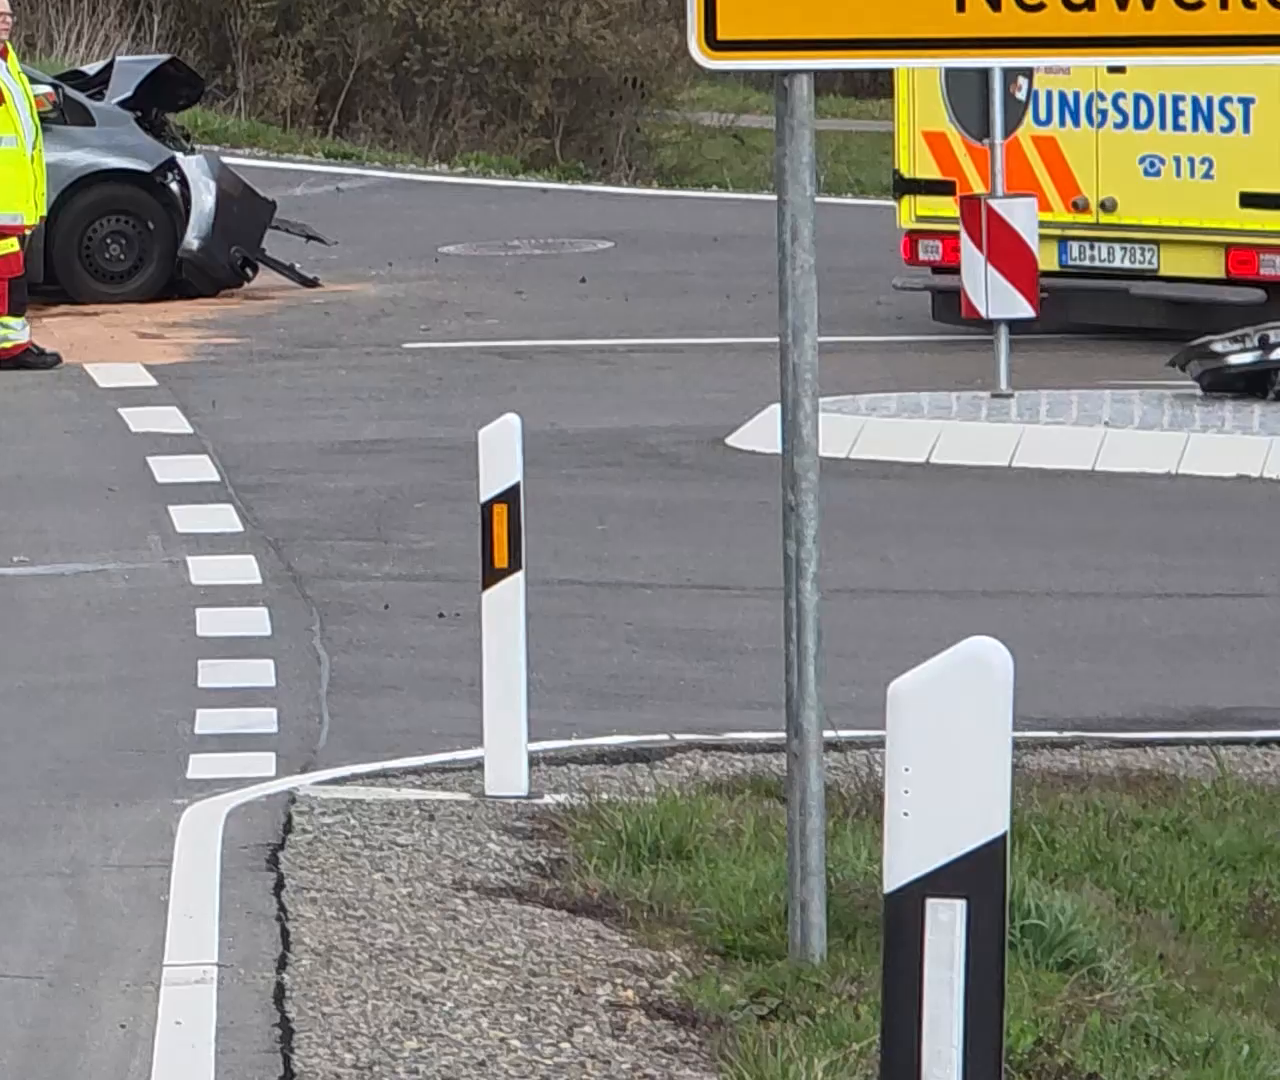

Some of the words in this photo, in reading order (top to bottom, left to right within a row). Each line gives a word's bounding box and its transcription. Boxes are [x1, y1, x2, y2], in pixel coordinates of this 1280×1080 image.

[1172, 154, 1215, 180] 112
[1068, 243, 1087, 263] LB
[1120, 246, 1156, 266] 7832
